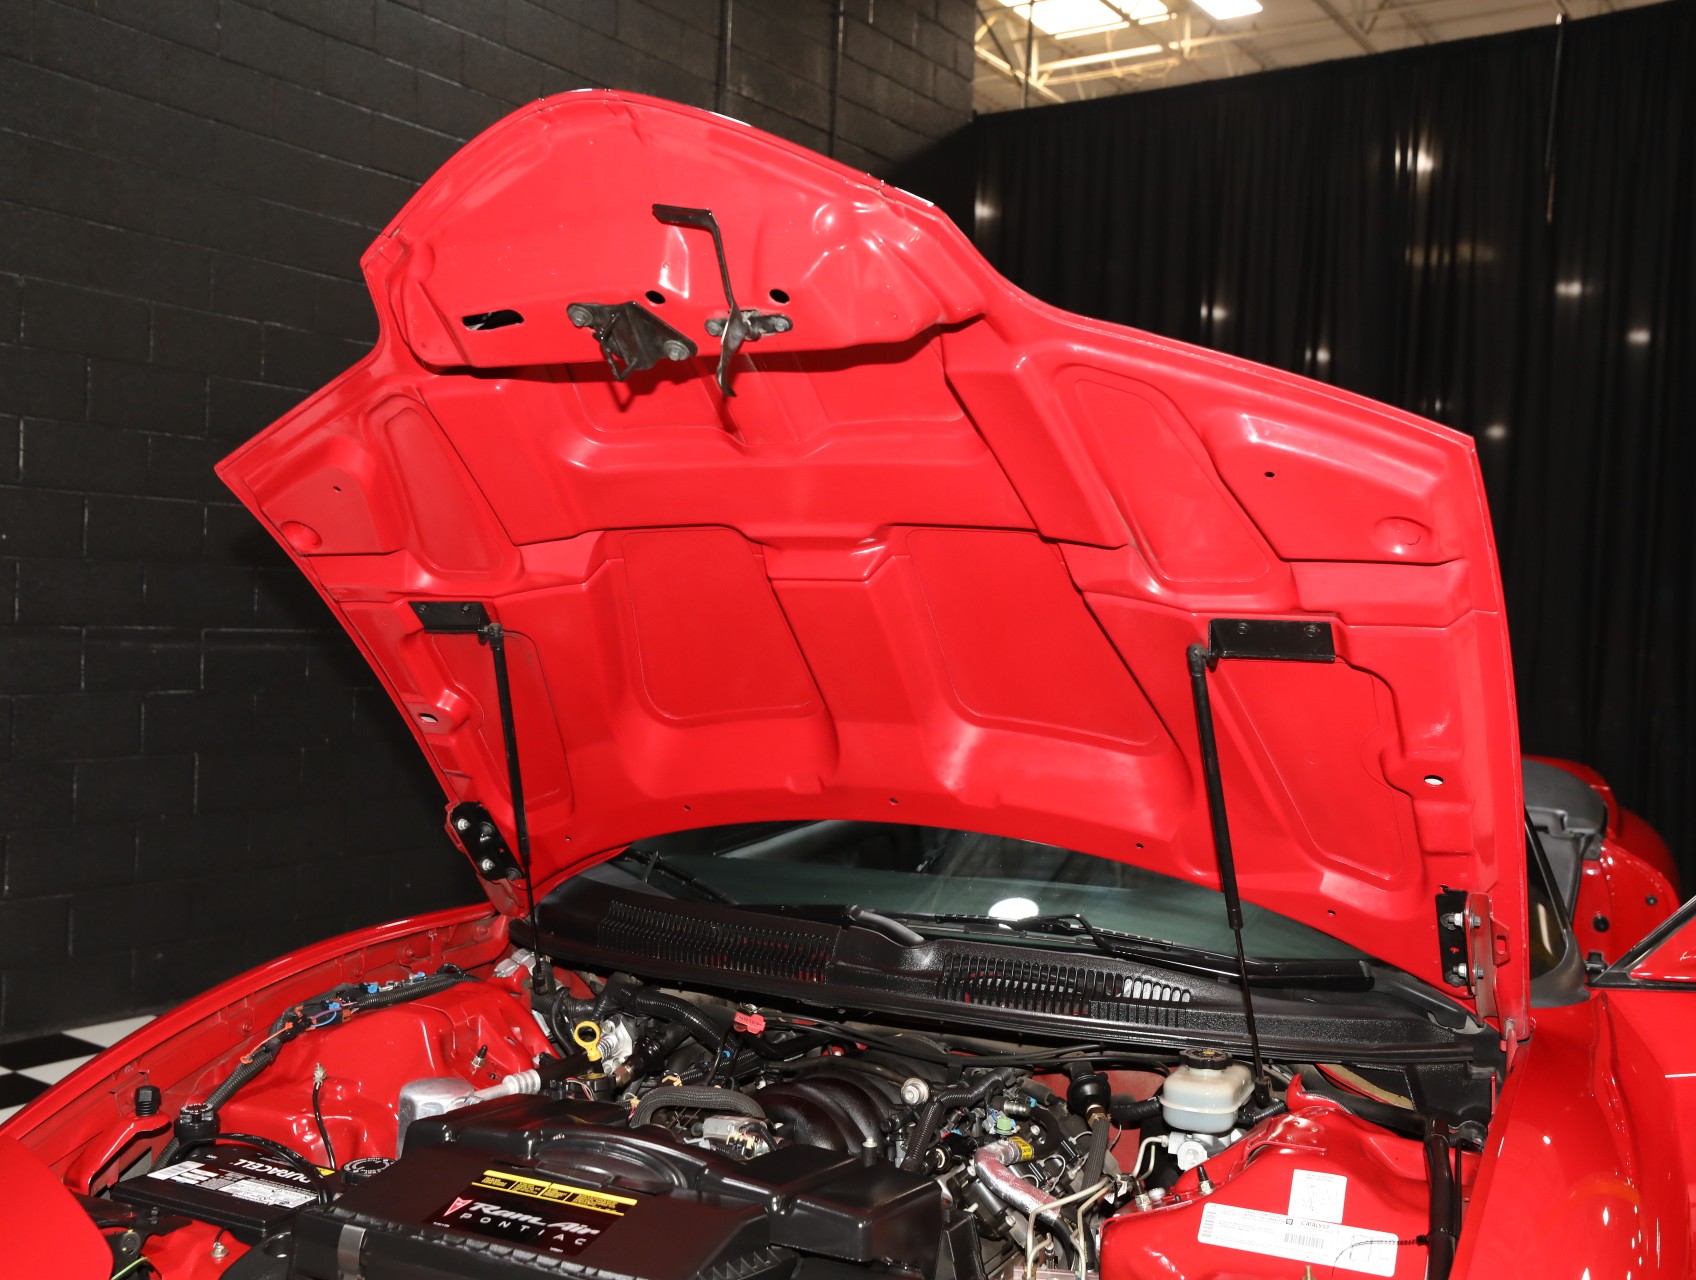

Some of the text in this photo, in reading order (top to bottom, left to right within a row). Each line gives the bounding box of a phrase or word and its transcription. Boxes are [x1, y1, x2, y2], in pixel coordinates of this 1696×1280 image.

[234, 1158, 312, 1184] DURACELL
[460, 1212, 588, 1246] PONTIAC
[469, 1201, 601, 1236] Ram Air
